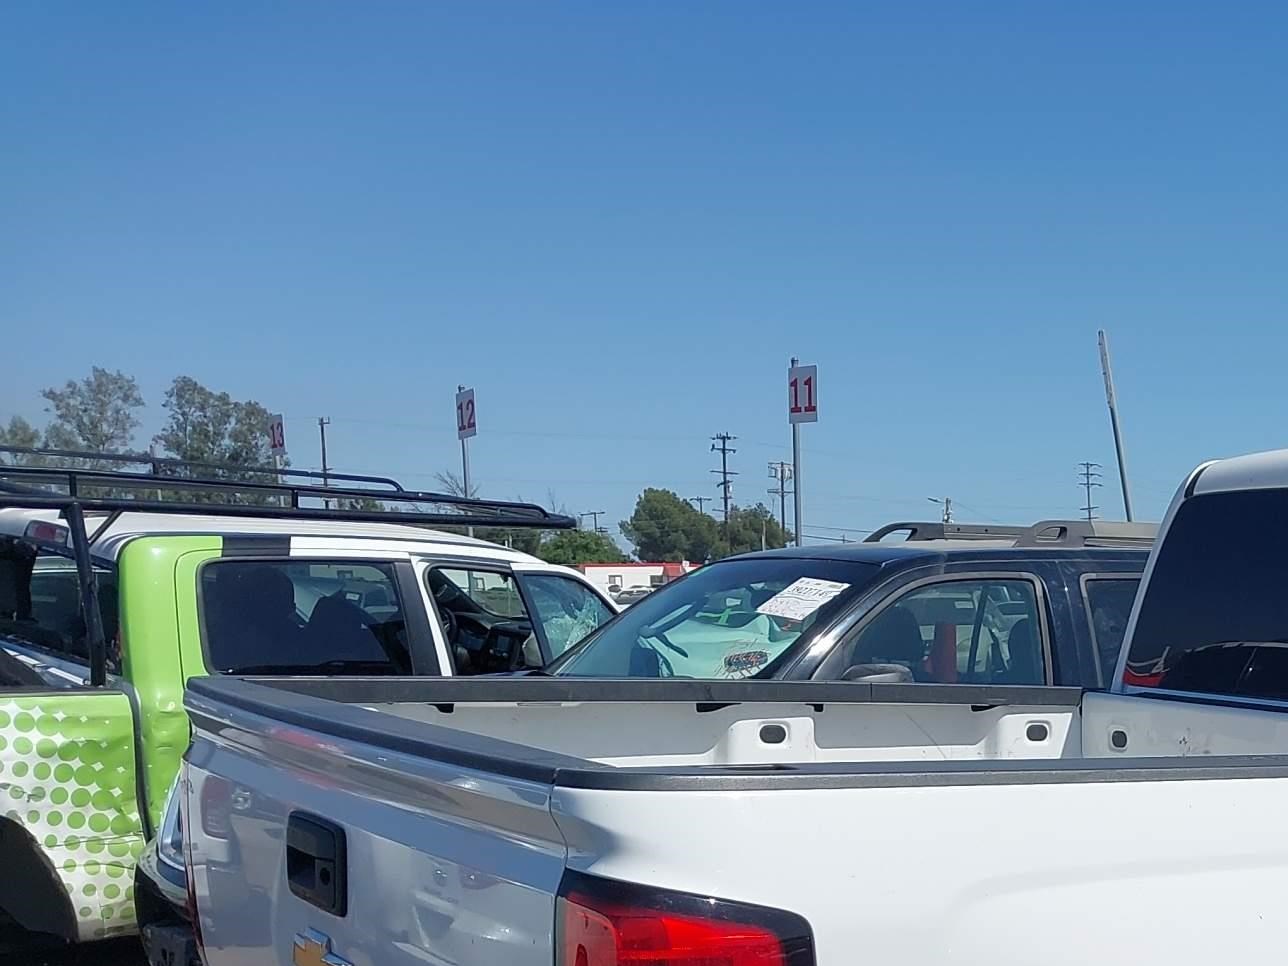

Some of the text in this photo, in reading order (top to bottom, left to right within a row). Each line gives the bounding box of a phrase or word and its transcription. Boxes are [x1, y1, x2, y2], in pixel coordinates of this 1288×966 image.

[790, 376, 816, 413] 11
[457, 399, 475, 431] 12
[270, 423, 284, 449] 13
